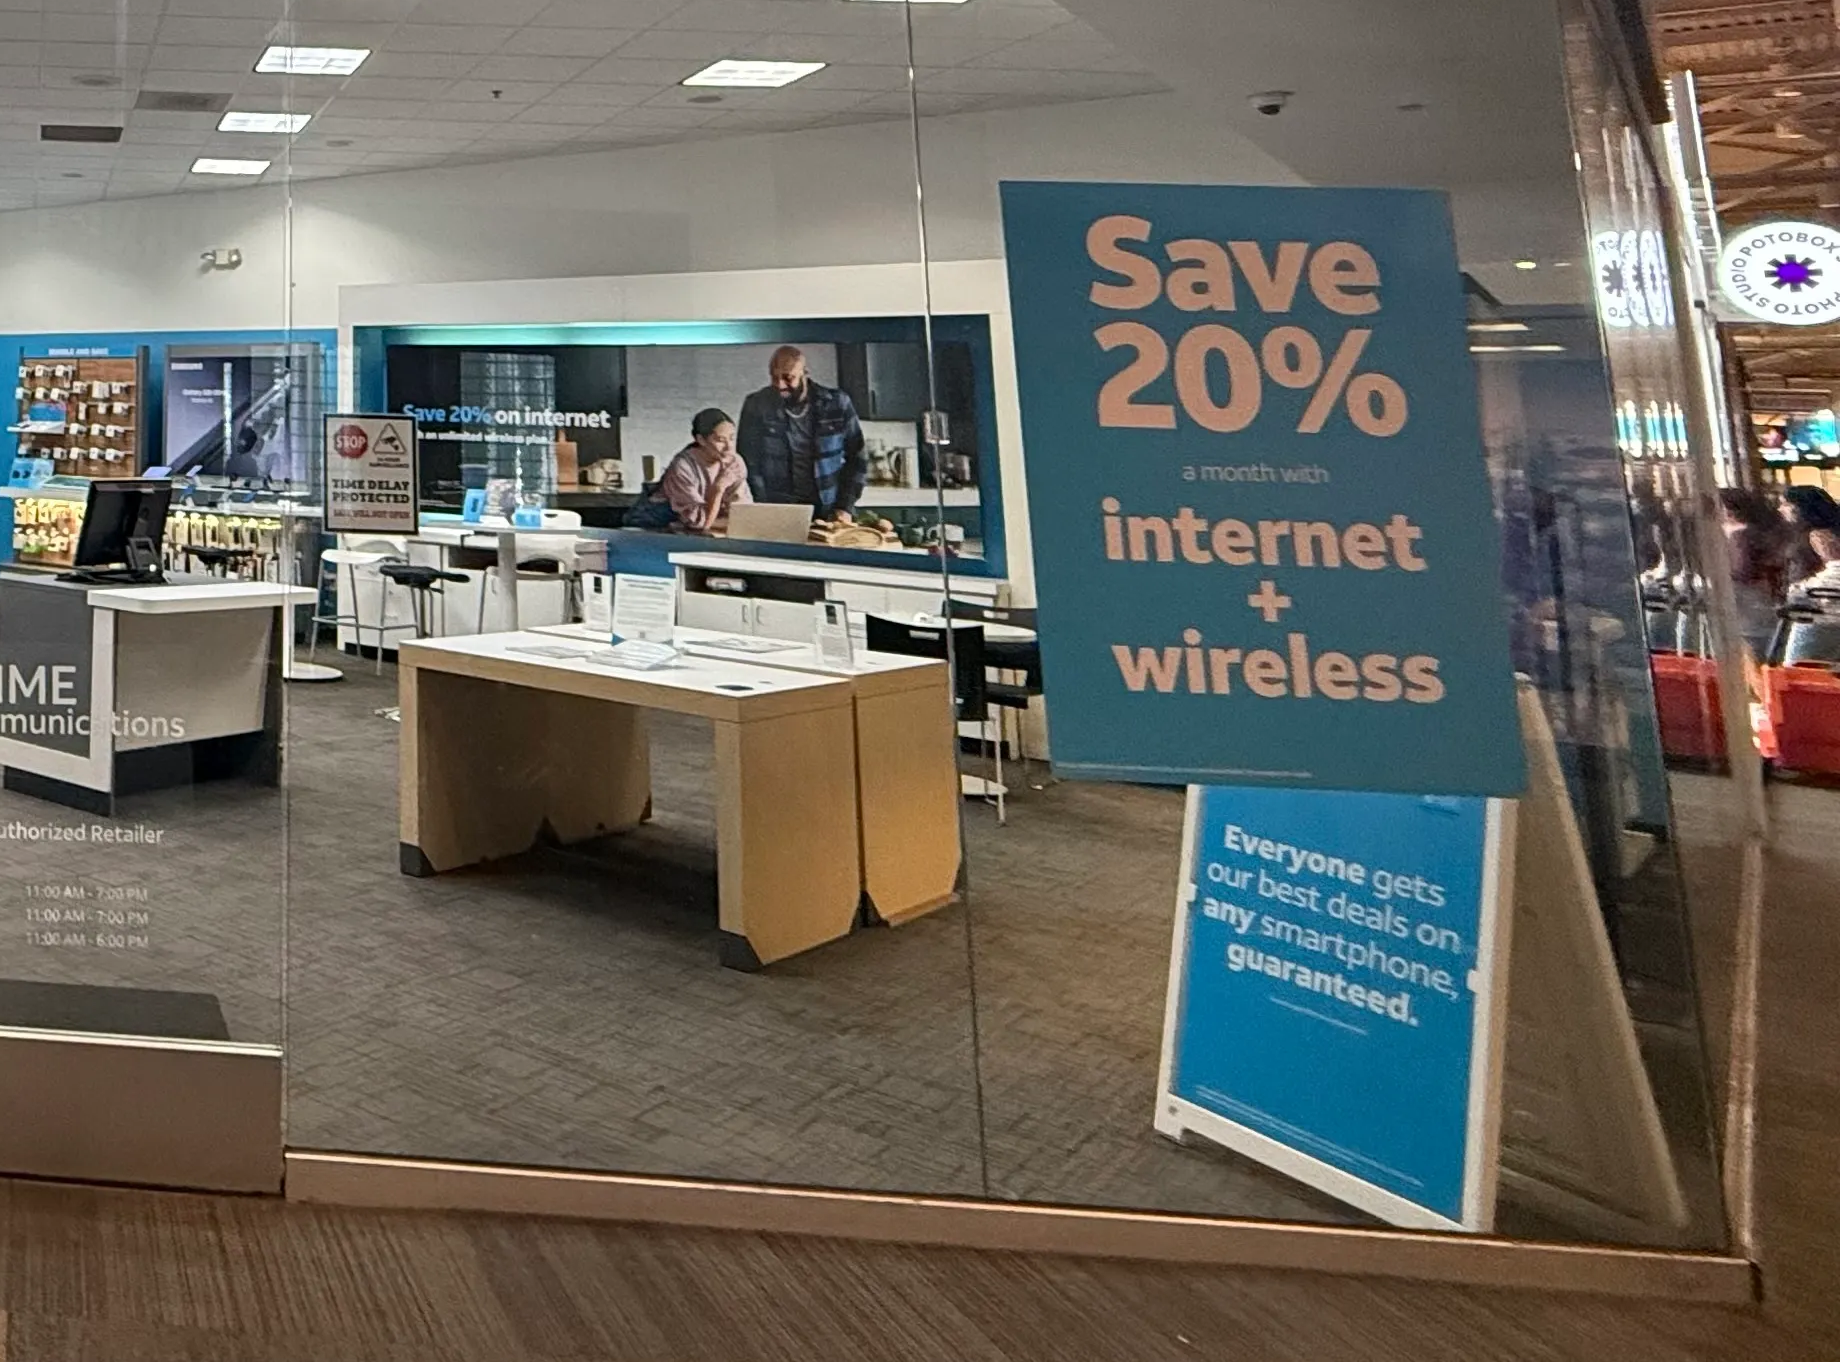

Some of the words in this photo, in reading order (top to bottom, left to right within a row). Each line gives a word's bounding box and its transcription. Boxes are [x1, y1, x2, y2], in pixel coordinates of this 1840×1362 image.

[1739, 231, 1840, 257] POTOBOX
[1085, 214, 1382, 316] Save
[1730, 258, 1771, 308] STUDIO
[1093, 321, 1408, 438] 20%
[403, 404, 447, 422] Save
[449, 405, 492, 425] 20%
[494, 409, 520, 426] on
[524, 405, 612, 428] internet
[336, 435, 366, 449] STOP
[332, 479, 365, 489] TIME
[368, 480, 410, 491] DELAY
[1182, 466, 1196, 482] a
[1200, 462, 1276, 483] month
[1280, 464, 1329, 484] with
[332, 492, 410, 504] PROTECTED
[1101, 496, 1428, 572] internet
[1111, 627, 1446, 705] wireless
[91, 825, 164, 844] Retailer
[1223, 823, 1366, 886] Everyone
[1371, 867, 1447, 908] gets
[63, 886, 85, 899] AM
[1207, 861, 1253, 889] our
[1258, 868, 1321, 913] best
[1327, 892, 1410, 939] deals
[1416, 922, 1461, 955] on
[63, 909, 85, 922] AM
[127, 911, 148, 924] PM
[1203, 895, 1256, 934] any
[1261, 913, 1460, 1002] smartphone,
[1227, 942, 1420, 1028] guaranteed.
